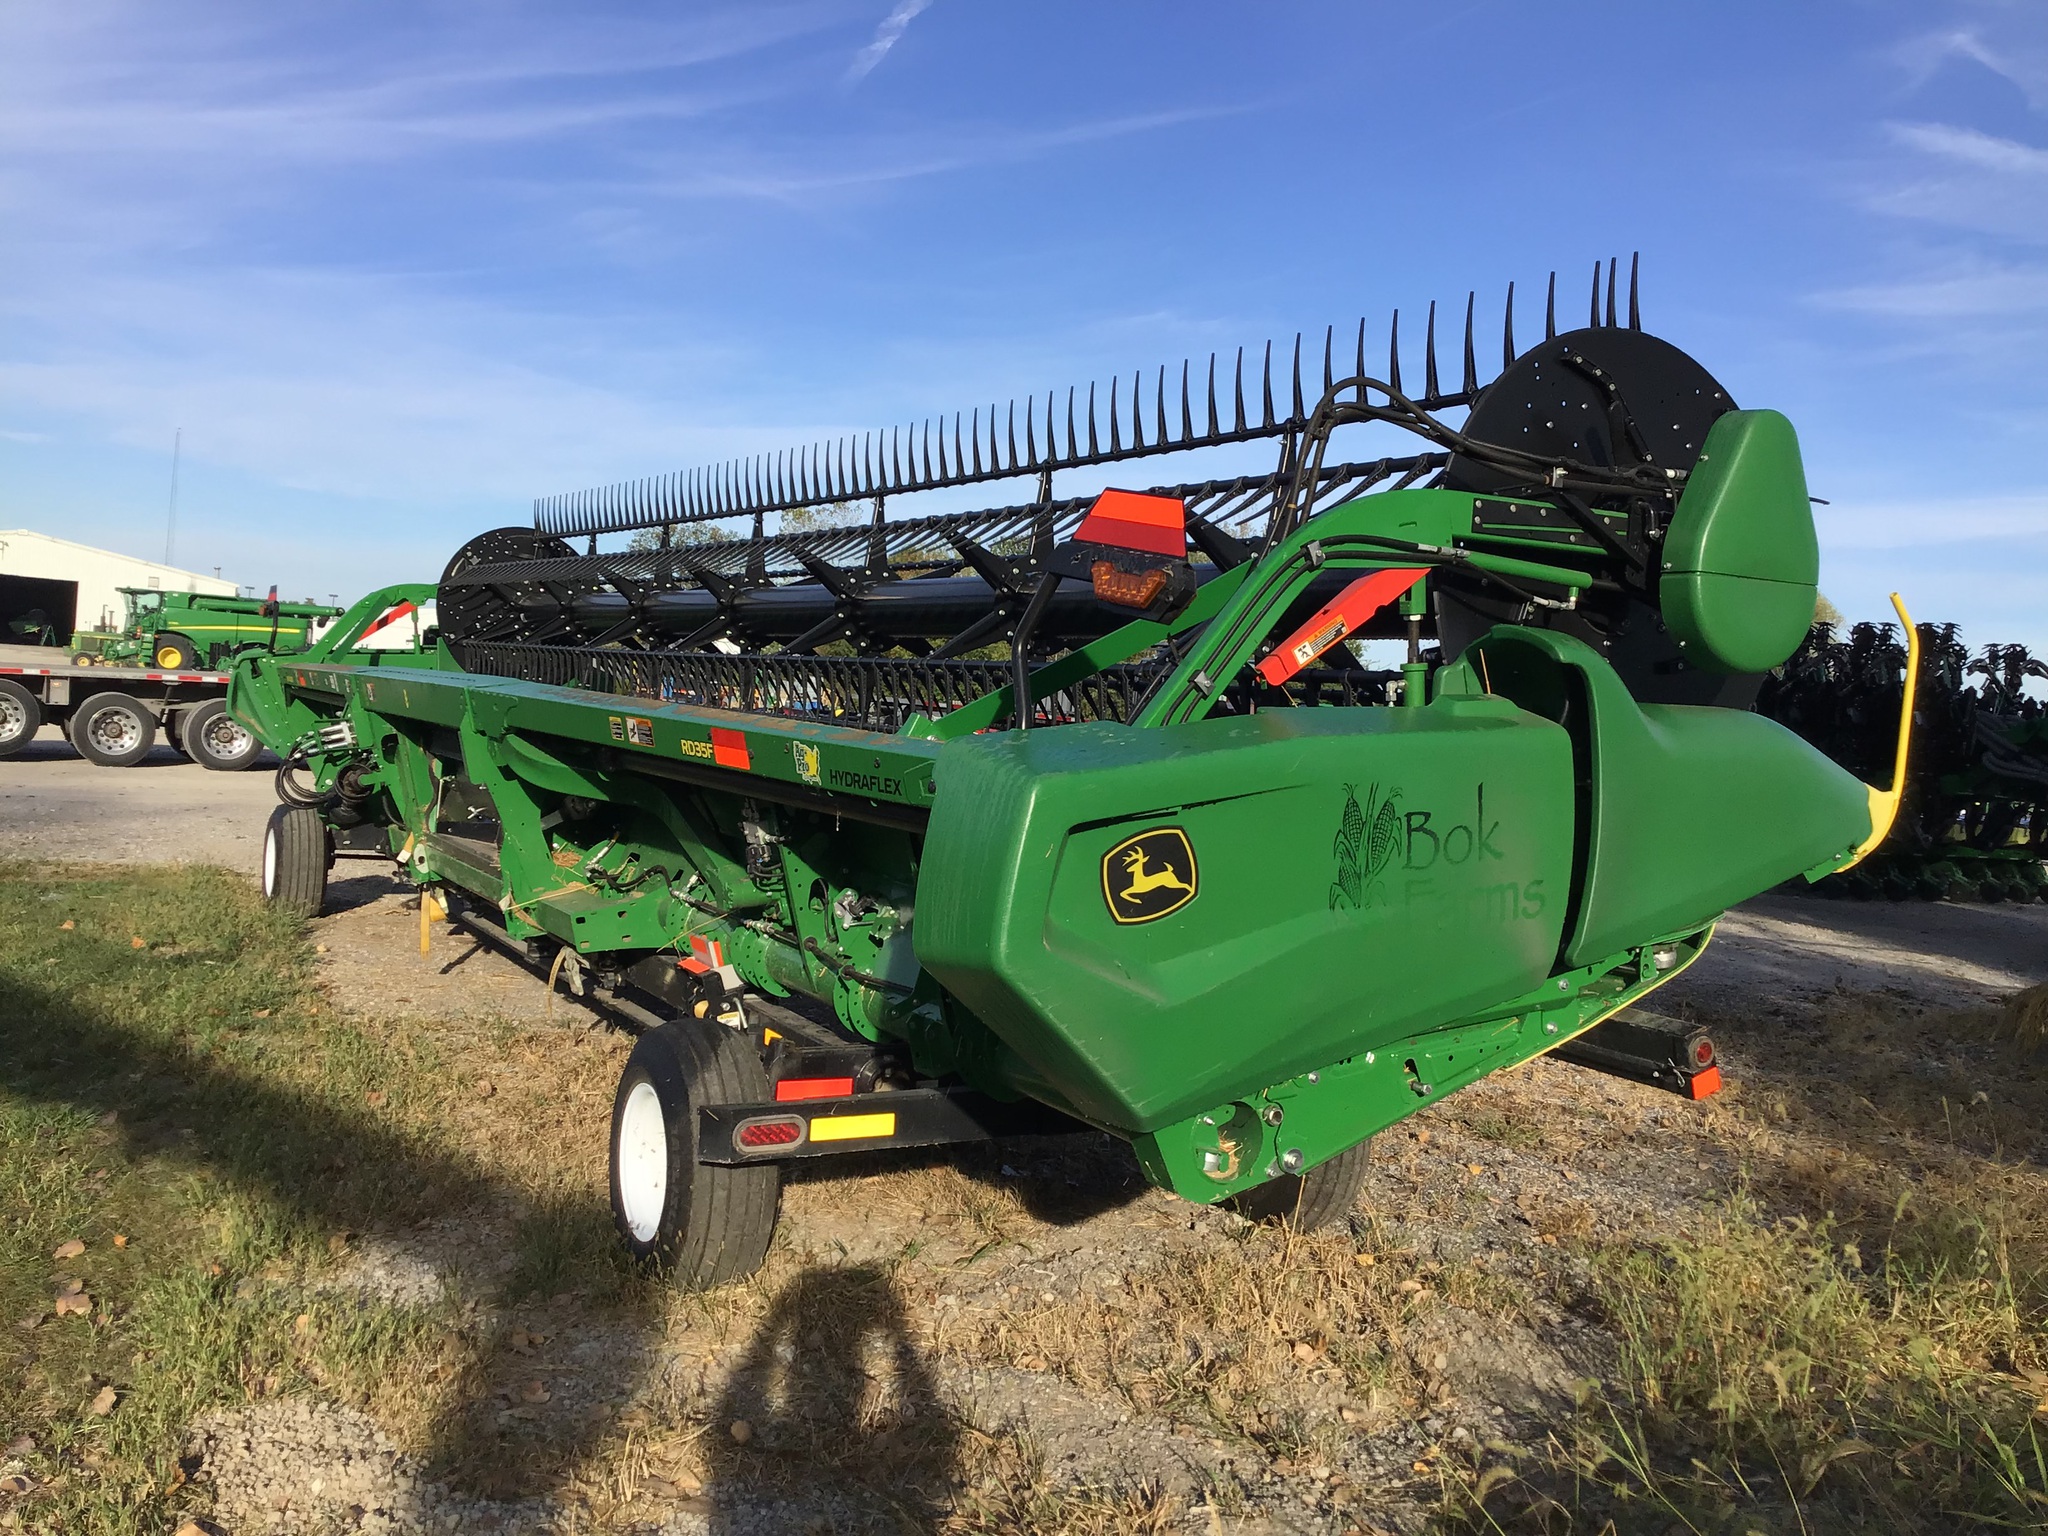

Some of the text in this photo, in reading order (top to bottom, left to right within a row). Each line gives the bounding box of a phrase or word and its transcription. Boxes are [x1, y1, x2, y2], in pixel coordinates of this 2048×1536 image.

[680, 739, 714, 759] RD35F
[829, 768, 903, 797] HYDRAFLEX
[1401, 782, 1505, 871] Bok
[1404, 878, 1548, 924] Fms
